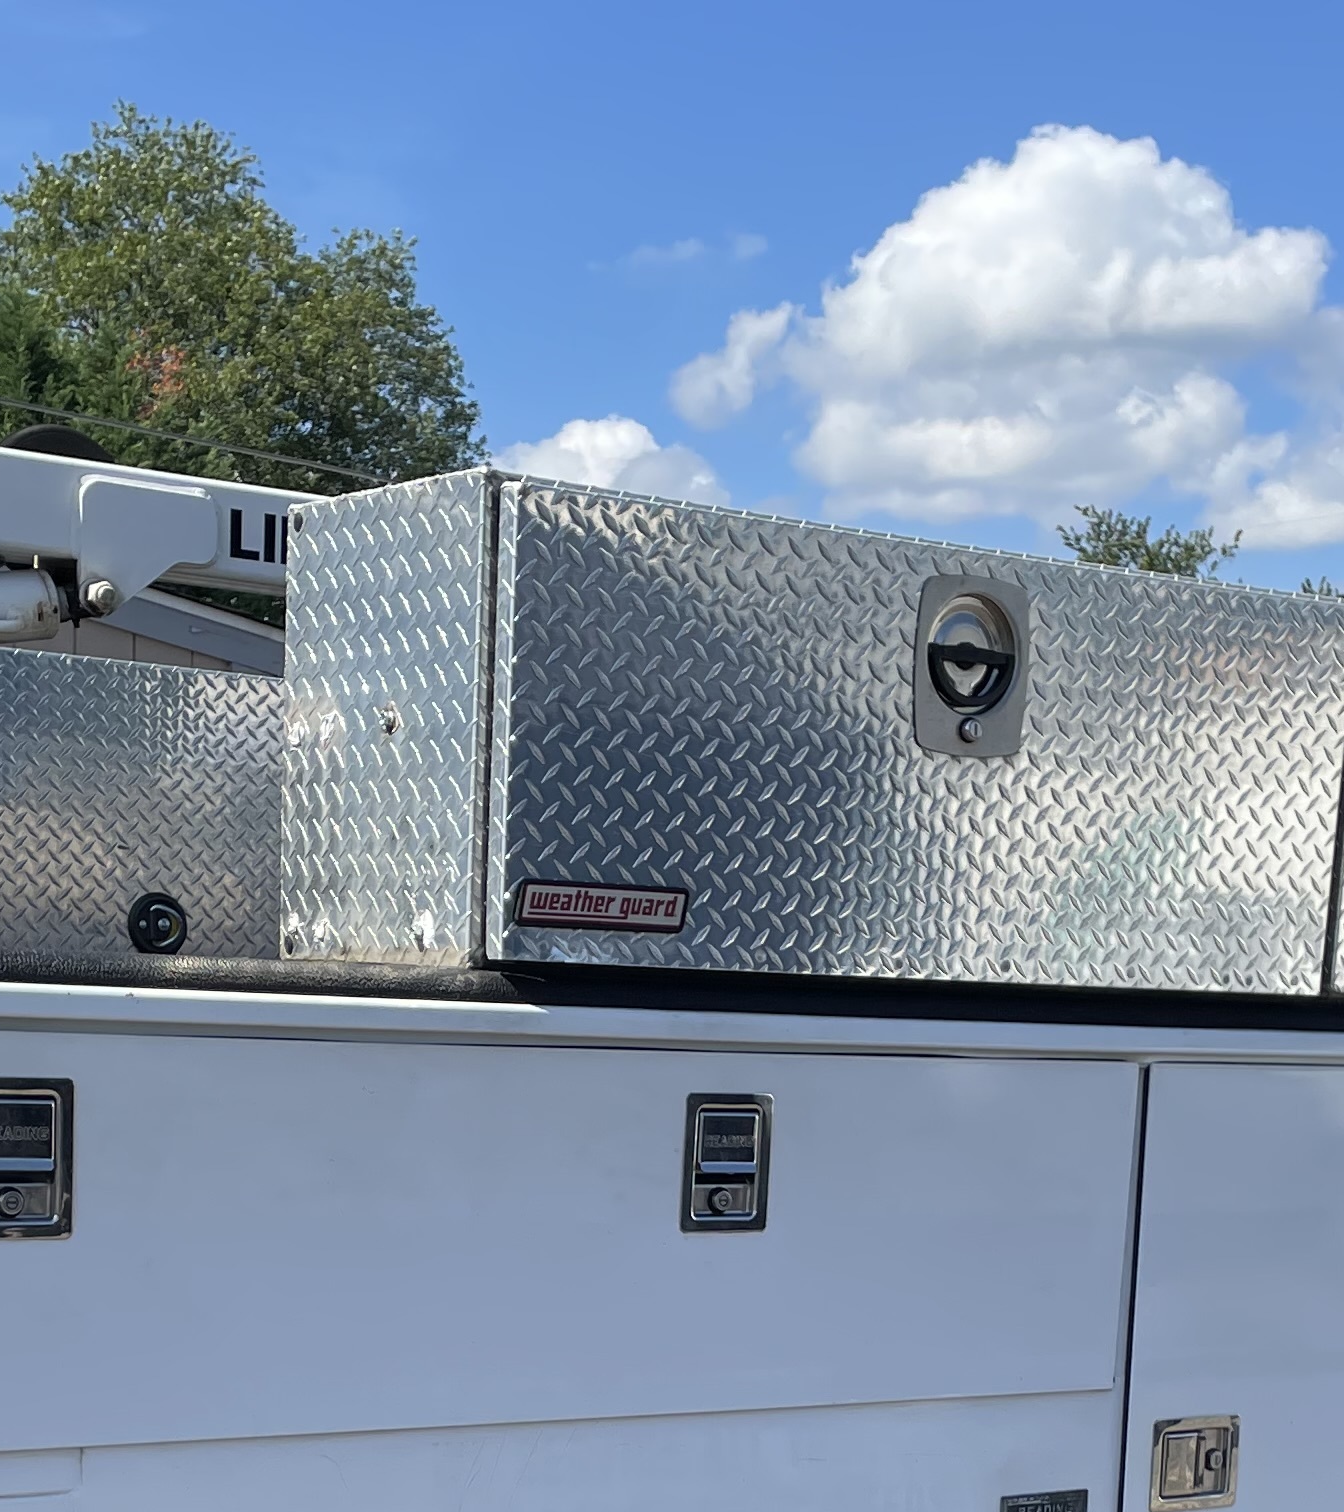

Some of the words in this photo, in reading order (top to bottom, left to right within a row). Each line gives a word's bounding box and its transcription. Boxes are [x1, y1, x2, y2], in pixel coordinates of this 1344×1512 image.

[230, 508, 288, 565] LI
[529, 890, 617, 914] weather
[619, 895, 678, 919] guard
